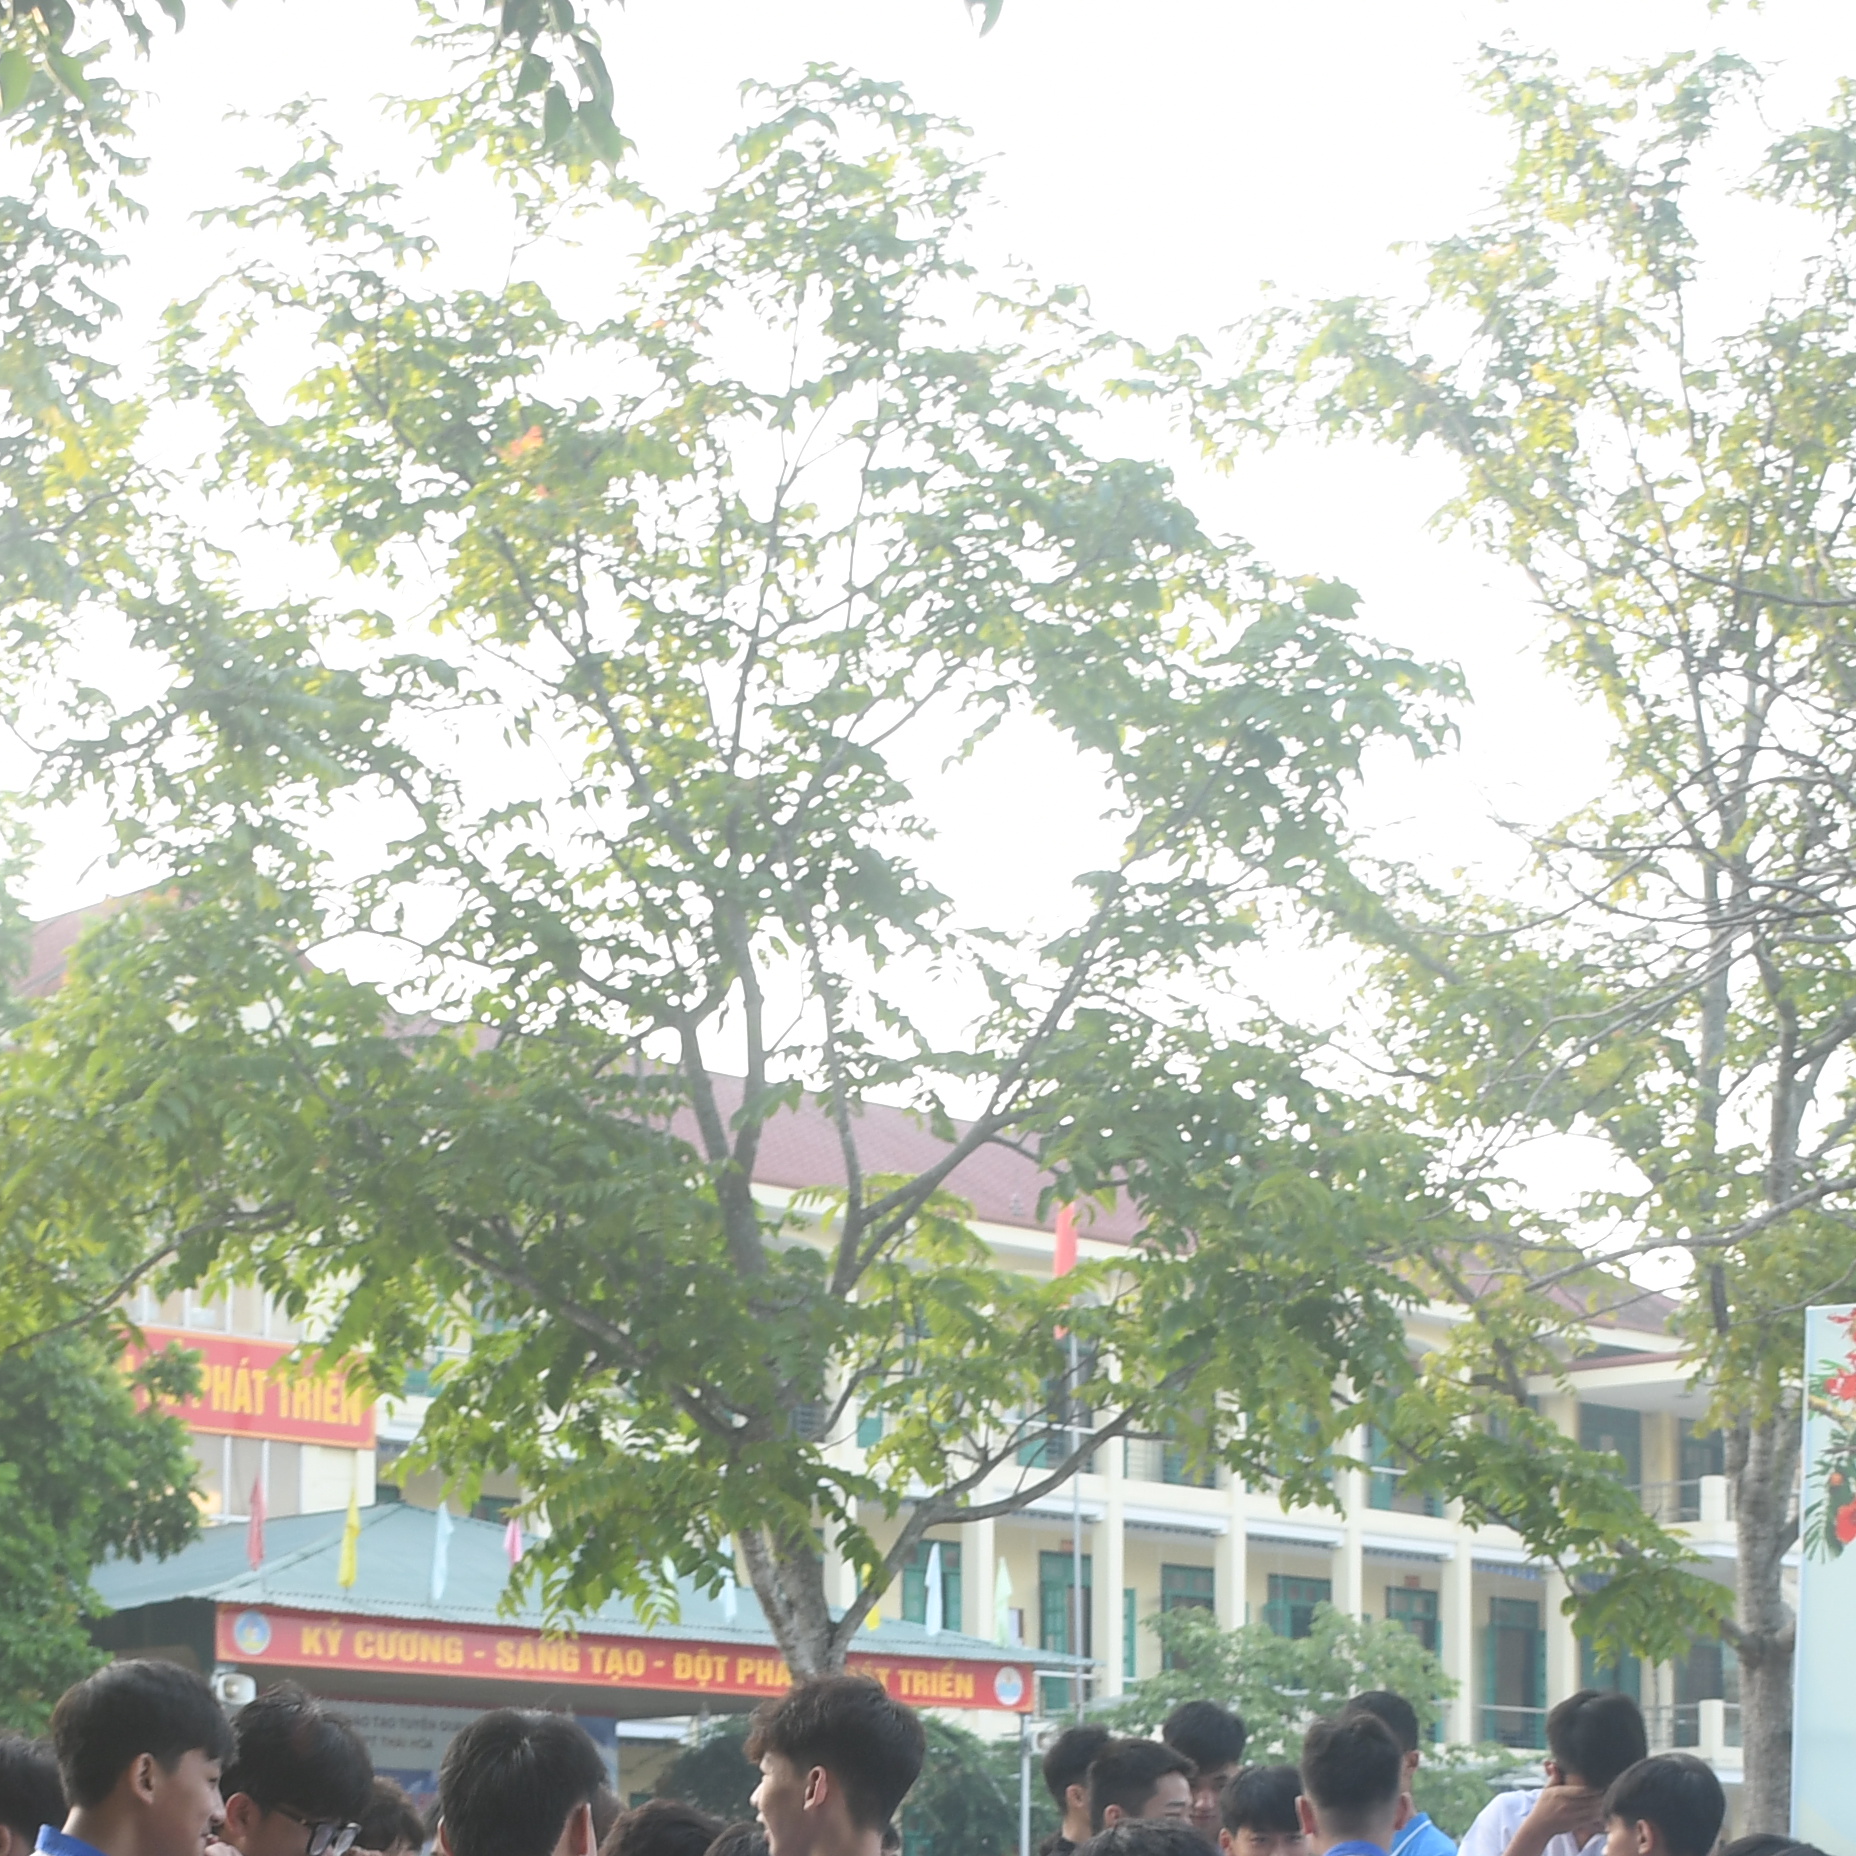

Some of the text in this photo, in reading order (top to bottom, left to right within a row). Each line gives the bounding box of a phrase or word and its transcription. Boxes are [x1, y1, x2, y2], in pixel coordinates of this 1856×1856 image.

[354, 1629, 464, 1665] CƯƠNG
[589, 1646, 646, 1682] TẠO
[673, 1648, 729, 1688] ĐỘT
